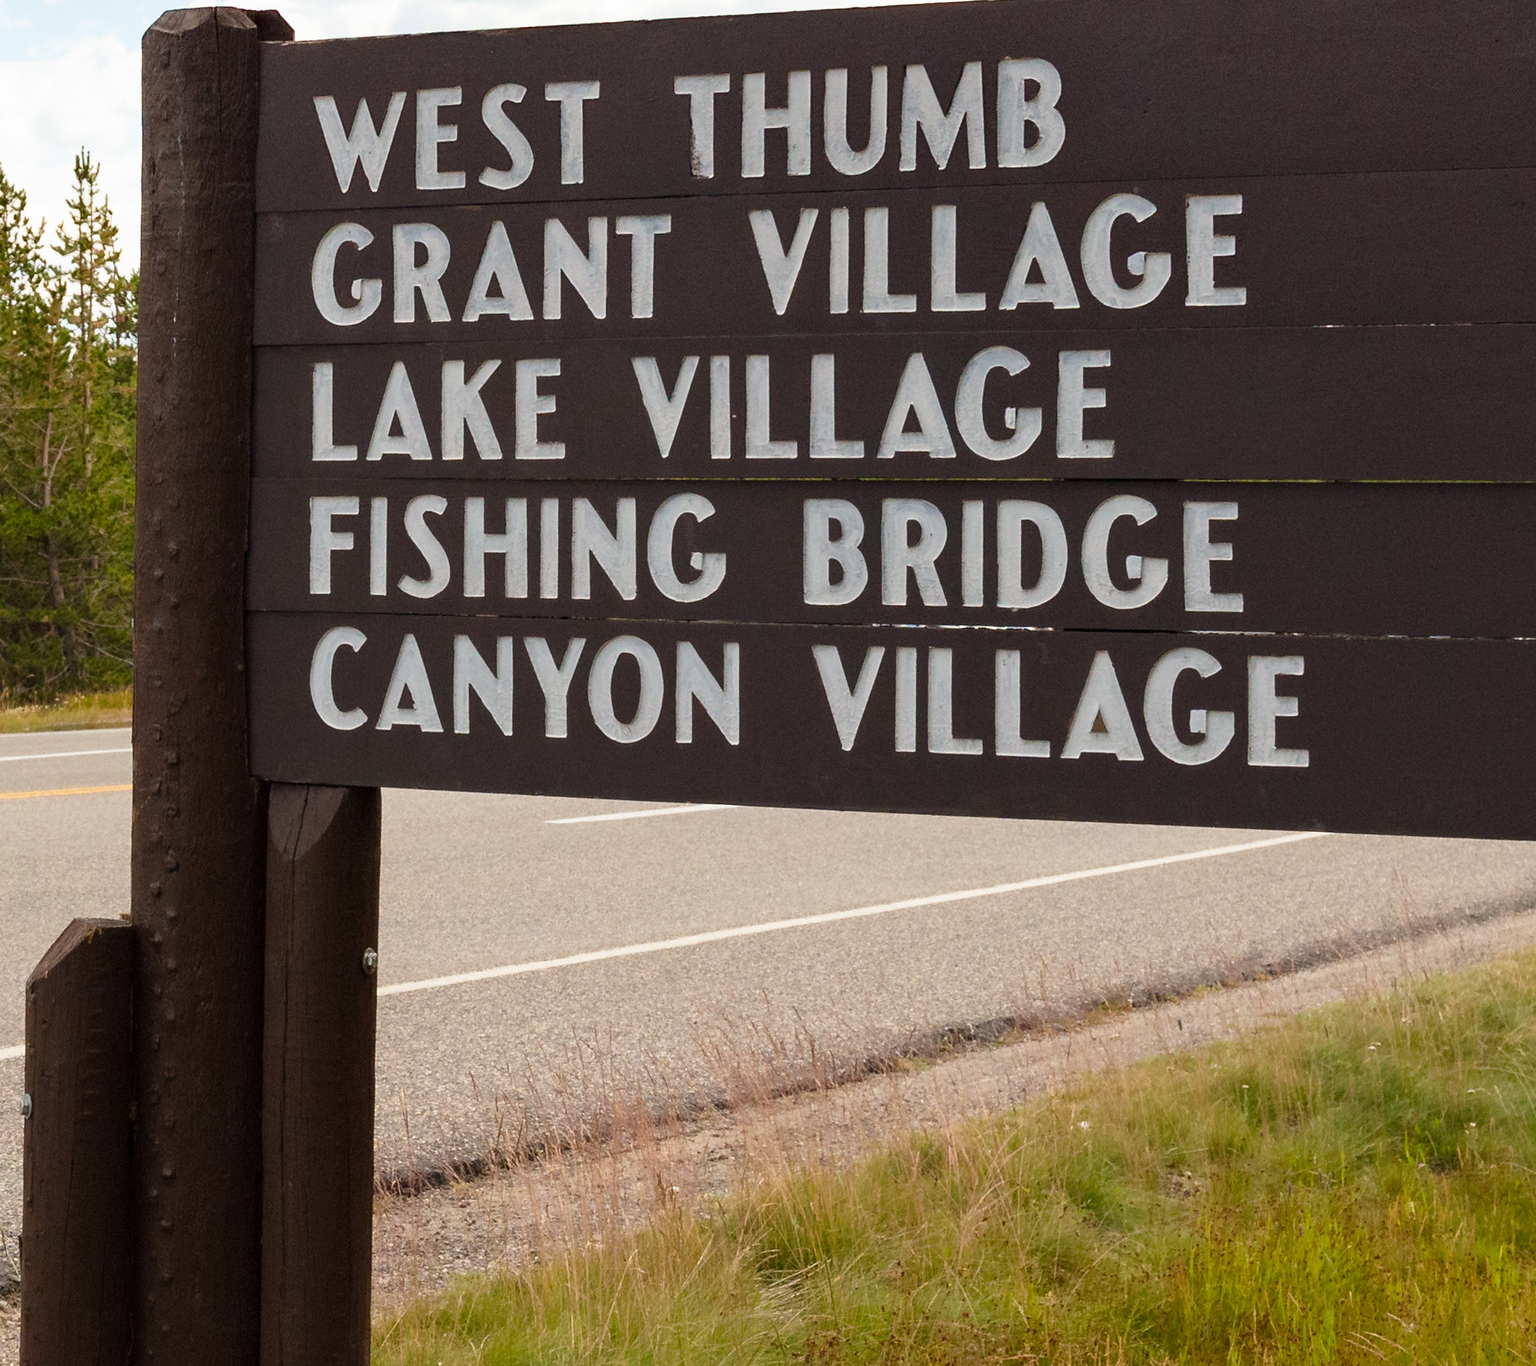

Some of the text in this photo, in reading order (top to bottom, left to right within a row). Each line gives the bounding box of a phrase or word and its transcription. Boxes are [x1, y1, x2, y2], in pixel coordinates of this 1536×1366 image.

[313, 59, 1065, 193] WEST THUMB
[311, 216, 672, 326] GRANT
[748, 194, 1247, 316] VILLAGE
[311, 359, 566, 462] LAKE
[632, 346, 1115, 461] VILLAGE
[309, 494, 727, 604] FISHING
[803, 495, 1244, 613] BRIDGE
[309, 627, 740, 746] CANYON
[812, 646, 1310, 768] VILLAGE
